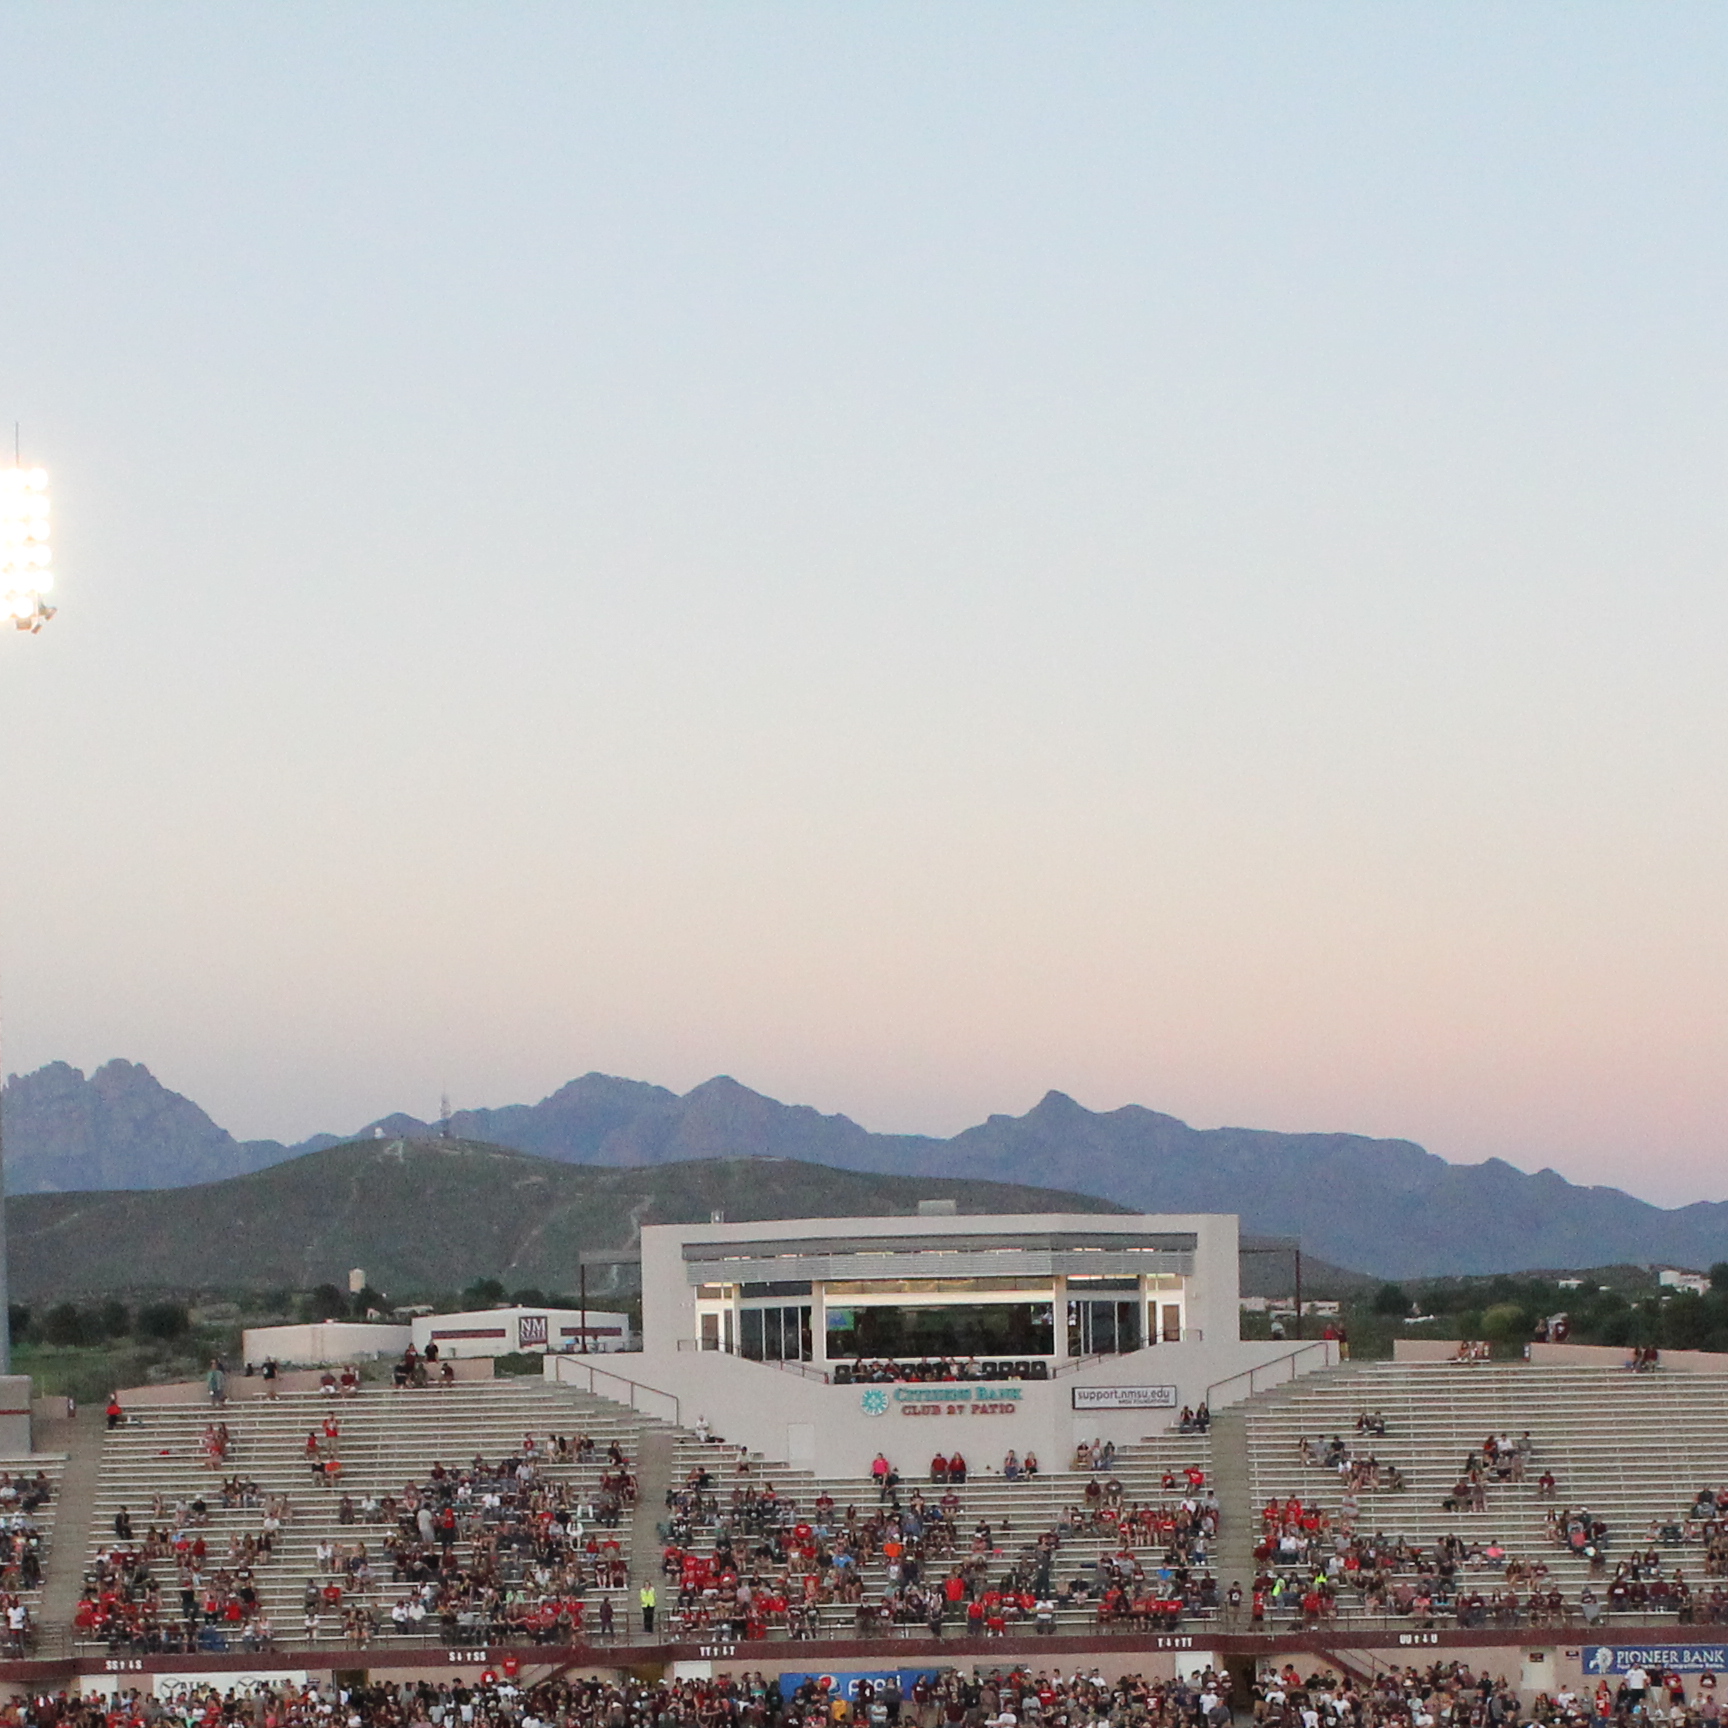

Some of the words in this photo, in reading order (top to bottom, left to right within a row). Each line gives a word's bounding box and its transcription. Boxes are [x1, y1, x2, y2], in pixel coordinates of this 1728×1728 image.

[521, 1318, 546, 1332] NM
[1077, 1387, 1170, 1401] support.nmsu.edu
[902, 1404, 941, 1416] CLUB
[972, 1403, 1016, 1415] PATIO
[1616, 1650, 1680, 1663] PIONEER
[1683, 1650, 1725, 1663] BANK
